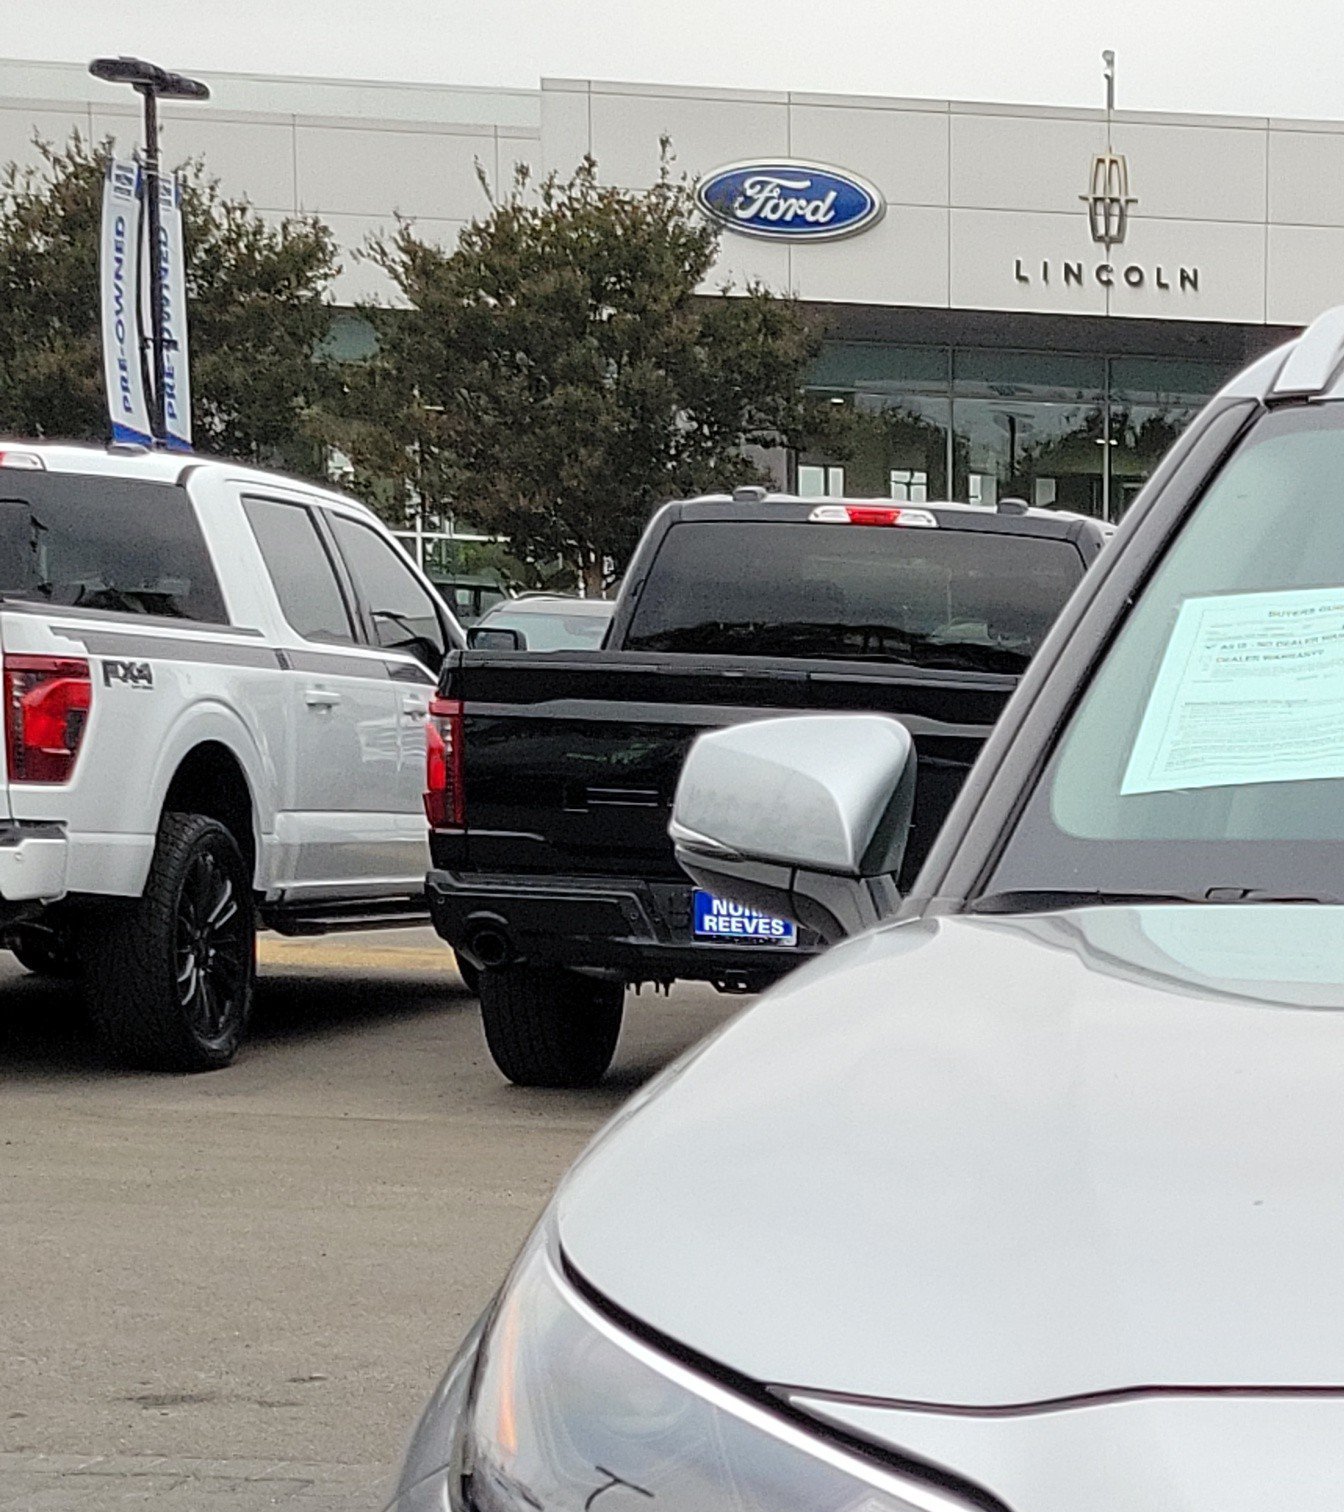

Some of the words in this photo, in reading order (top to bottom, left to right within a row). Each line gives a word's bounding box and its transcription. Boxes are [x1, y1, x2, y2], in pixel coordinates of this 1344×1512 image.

[734, 175, 837, 224] Ford
[1015, 258, 1201, 292] LINCOLN
[113, 215, 133, 414] PRE-OWNED
[102, 660, 153, 687] FX4
[703, 914, 785, 935] REEVES
